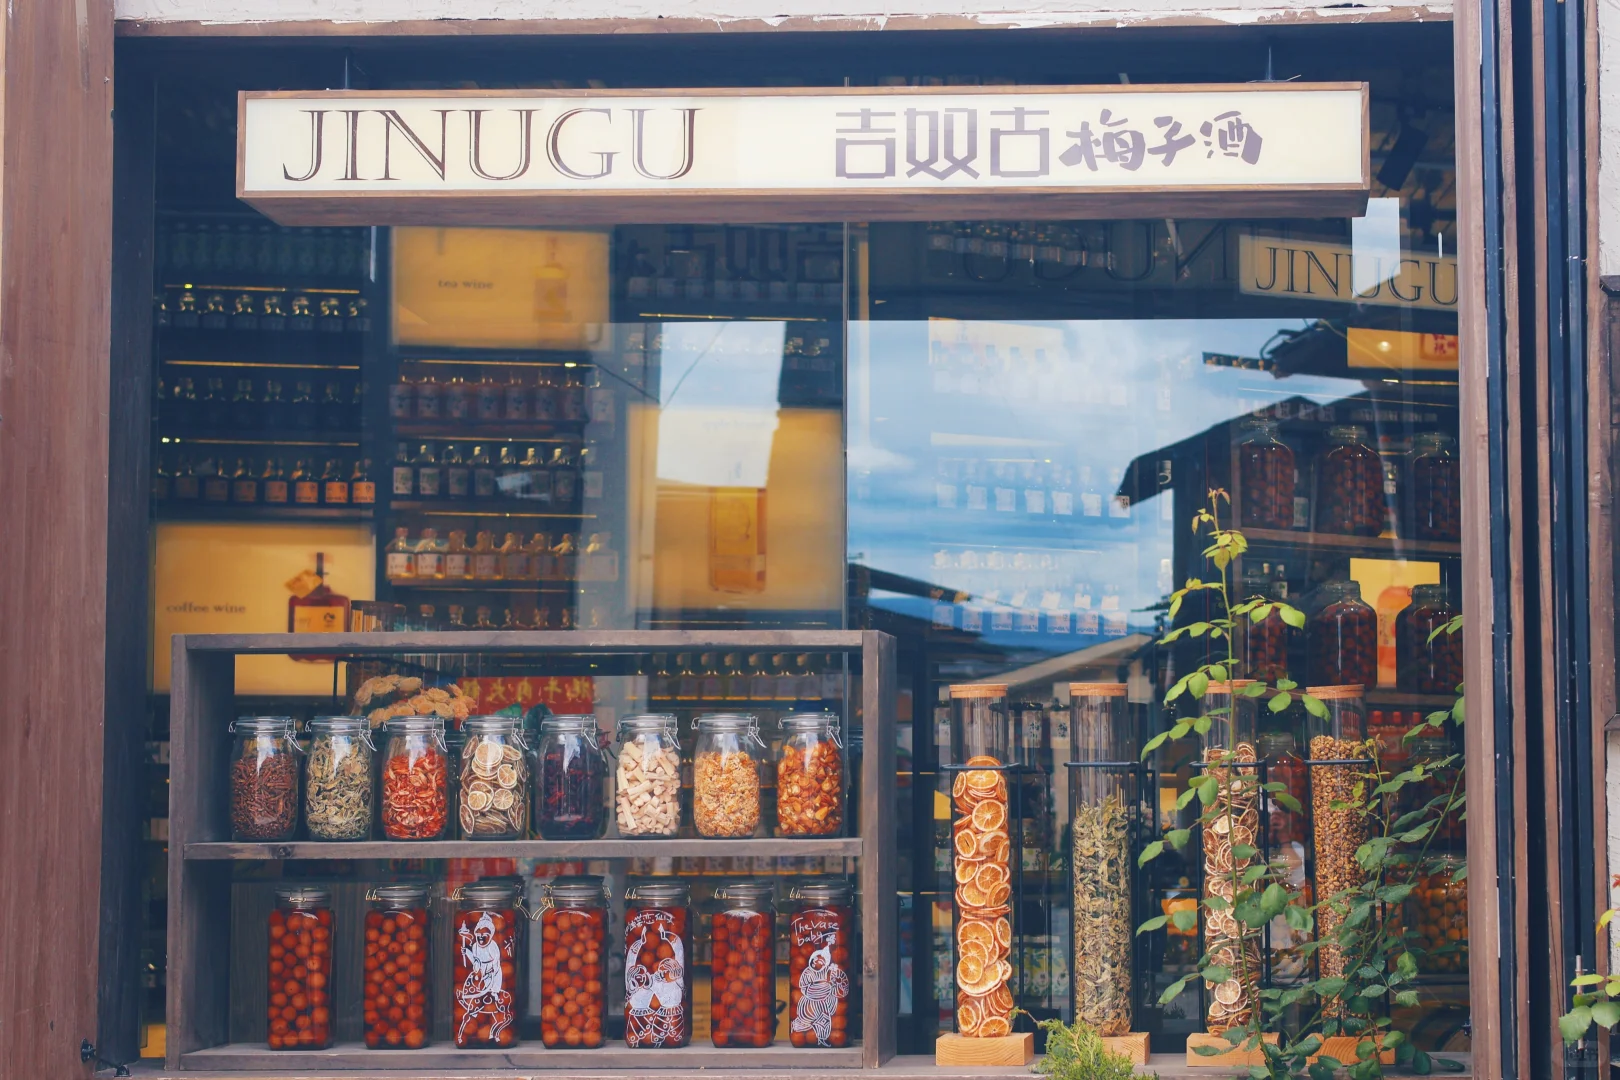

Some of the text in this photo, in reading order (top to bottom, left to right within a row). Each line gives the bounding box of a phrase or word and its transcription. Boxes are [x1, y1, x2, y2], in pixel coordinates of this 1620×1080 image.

[283, 107, 703, 182] JINUGU
[462, 279, 494, 289] wine
[1255, 247, 1457, 306] JINUGU
[166, 601, 246, 613] coffee wine
[791, 916, 812, 936] The
[797, 930, 837, 947] baby
